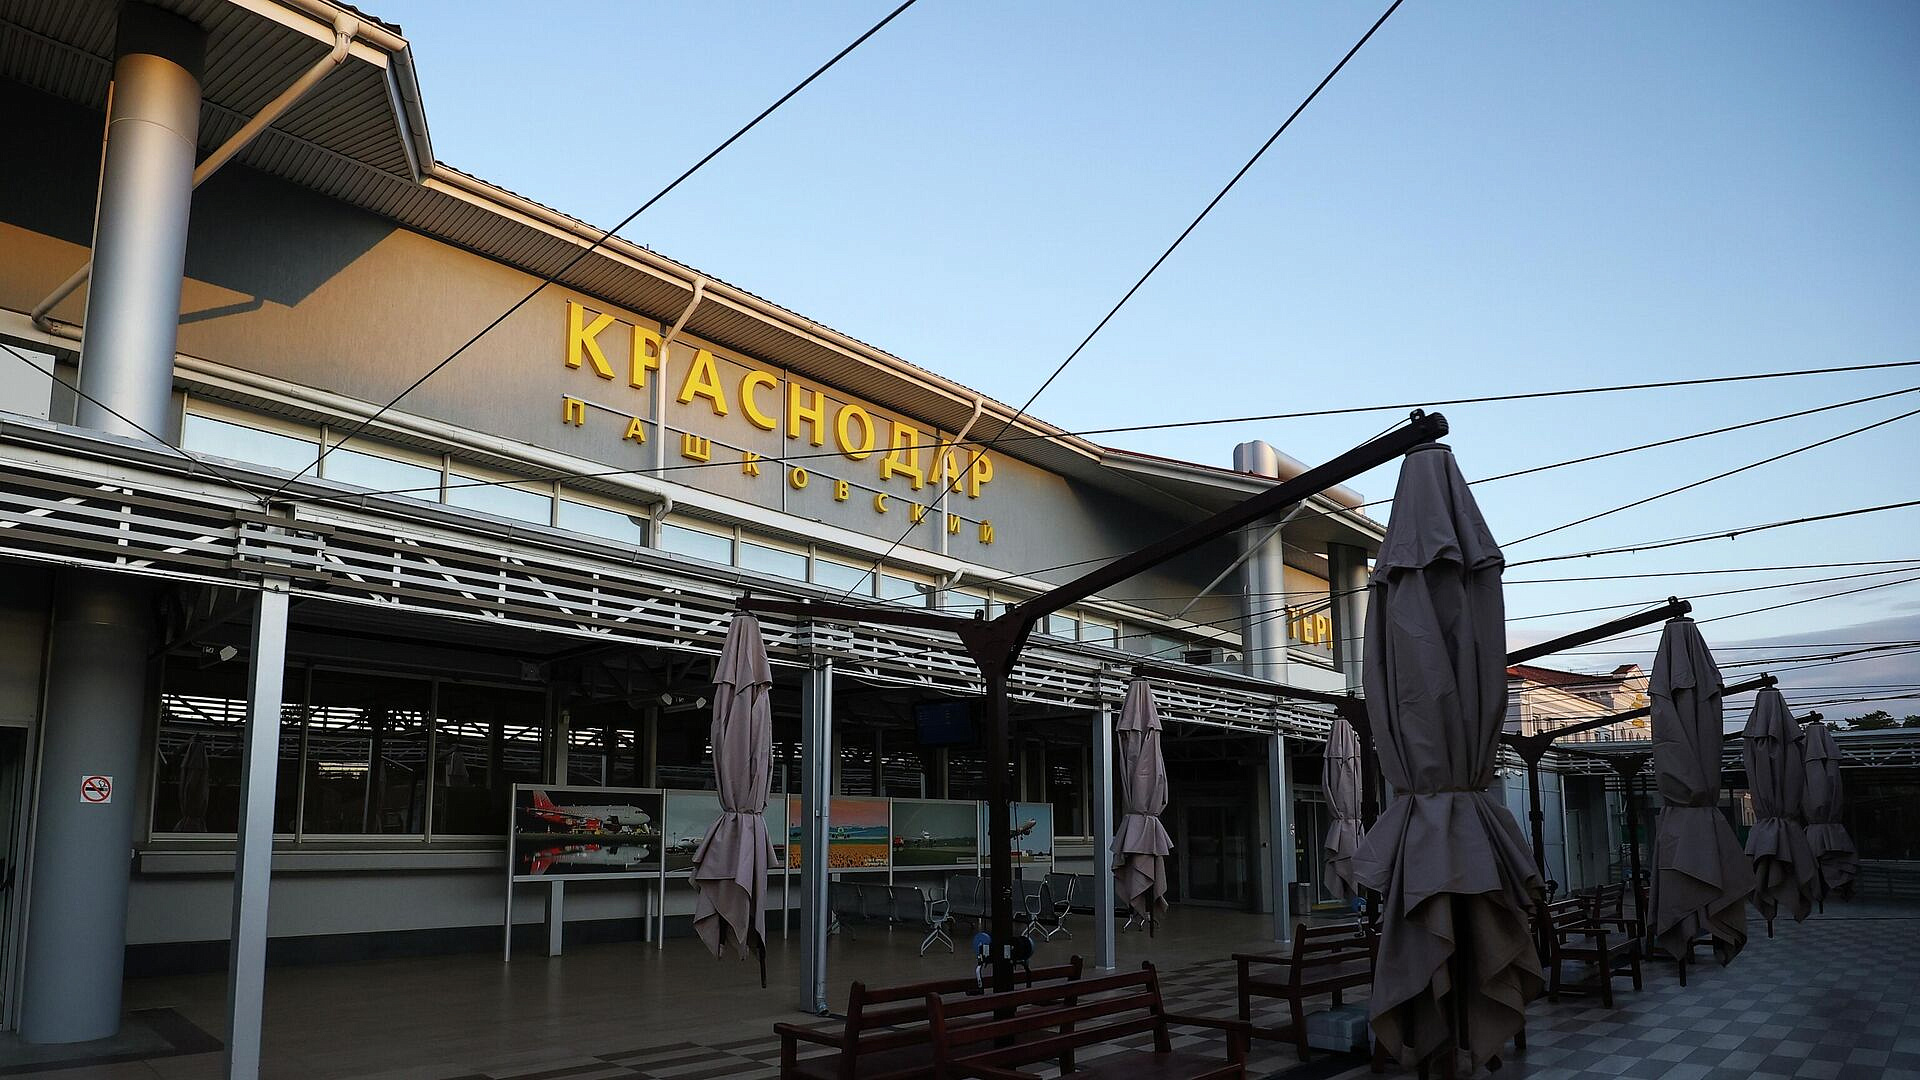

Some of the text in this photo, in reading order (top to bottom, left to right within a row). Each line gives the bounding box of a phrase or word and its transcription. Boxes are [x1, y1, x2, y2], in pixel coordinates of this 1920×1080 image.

[563, 397, 994, 545] ПАШКОВСКИЙ
[565, 301, 994, 498] КРАСНОДАР
[1287, 605, 1333, 649] ТЕР
